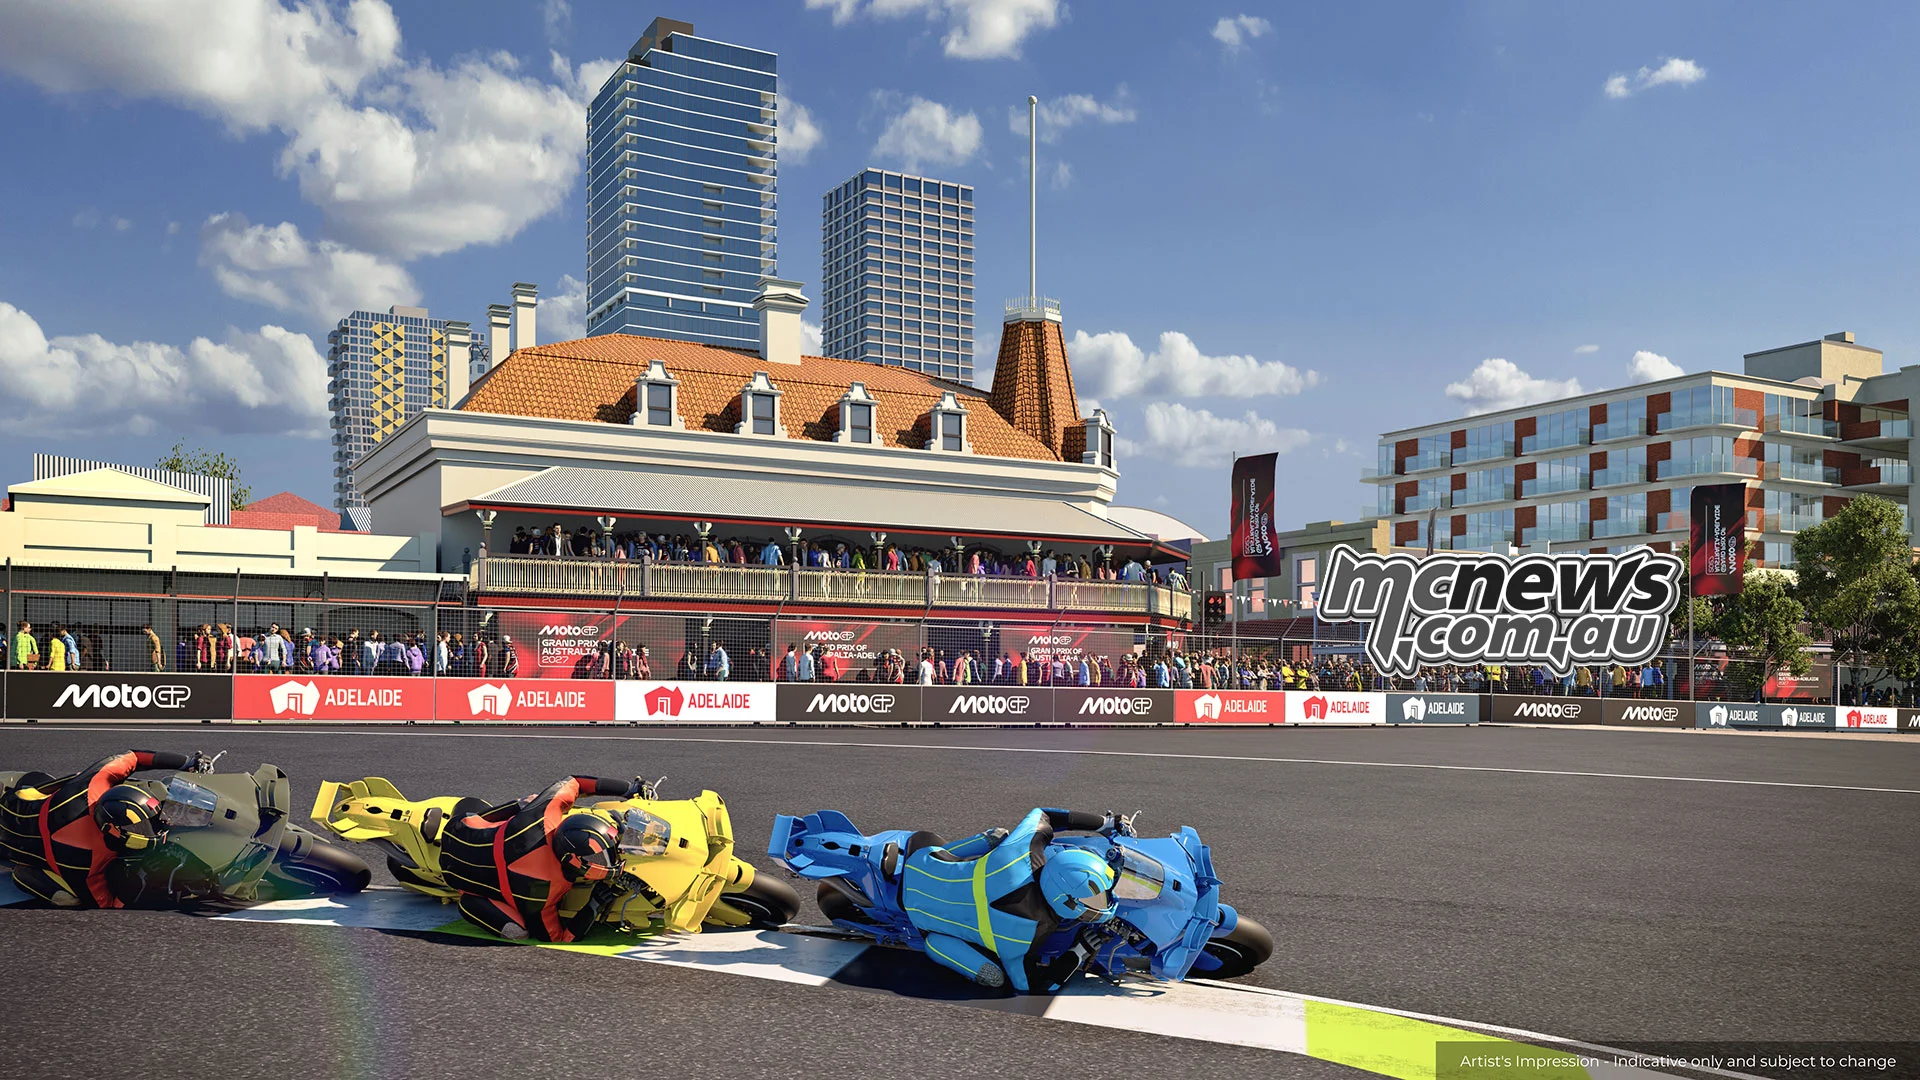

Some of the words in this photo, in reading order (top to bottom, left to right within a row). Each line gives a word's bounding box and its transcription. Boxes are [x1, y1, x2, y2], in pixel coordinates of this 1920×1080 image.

[538, 625, 599, 636] MotoGP
[803, 630, 855, 641] MotoGP
[541, 639, 577, 647] GRAND
[578, 639, 599, 648] PRIX
[541, 655, 569, 664] 2027
[52, 683, 192, 709] MotoGP
[324, 688, 403, 707] ADELAIDE
[516, 690, 586, 708] ADELAIDE
[687, 693, 751, 709] ADELAIDE
[806, 693, 896, 713] MotoGP
[949, 695, 1030, 714] MotoGP
[1079, 697, 1153, 715] MotoGP
[1223, 699, 1268, 713] ADELAIDE
[1330, 701, 1370, 714] ADELAIDE
[1427, 701, 1465, 714] ADELAIDE
[1513, 702, 1582, 719] MotoGP
[1621, 706, 1679, 722] MotoGP
[1729, 709, 1759, 722] ADELAIDE
[1798, 711, 1826, 723] ADELAIDE
[1863, 714, 1888, 724] ADELAIDE
